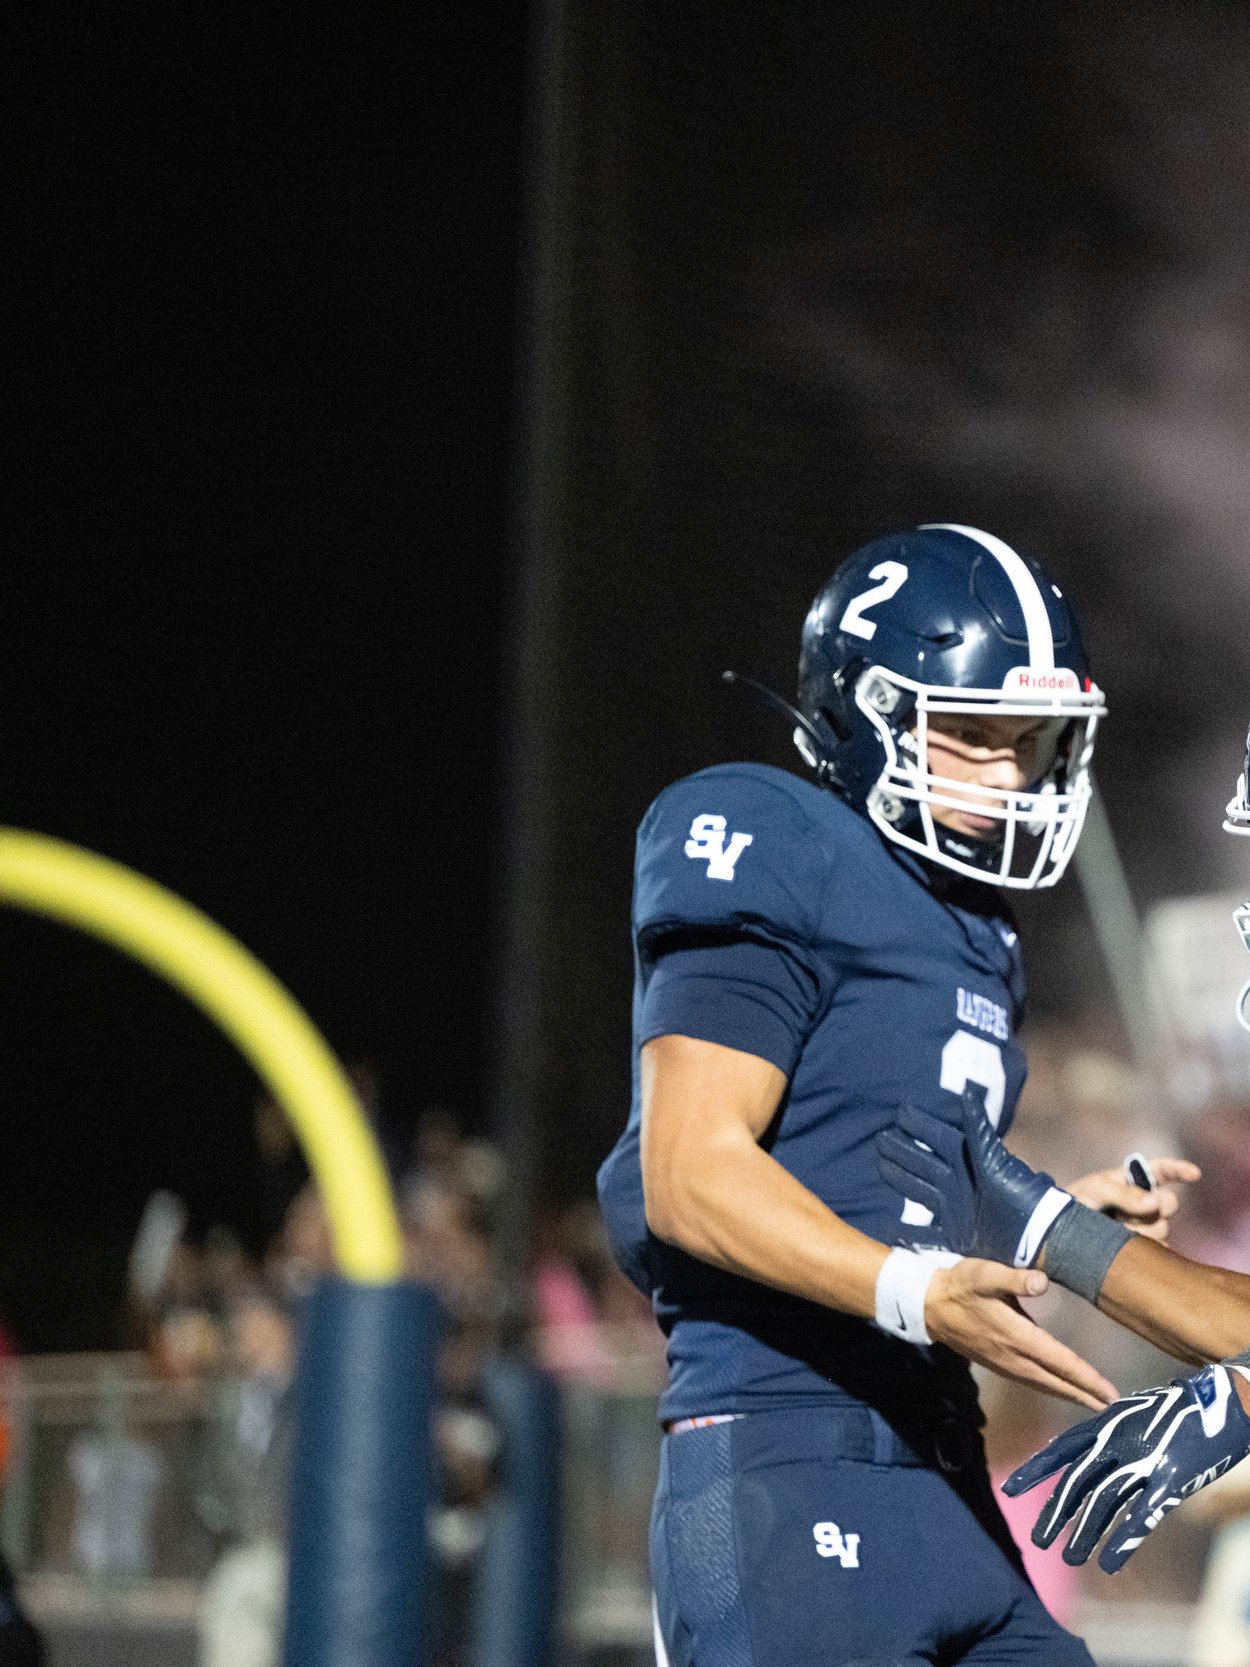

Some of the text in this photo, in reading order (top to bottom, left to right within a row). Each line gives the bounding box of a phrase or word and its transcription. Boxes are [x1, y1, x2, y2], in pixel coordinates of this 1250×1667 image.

[840, 561, 909, 641] 2
[1019, 673, 1074, 689] Ridde
[685, 813, 753, 881] SV
[813, 1521, 861, 1568] SV
